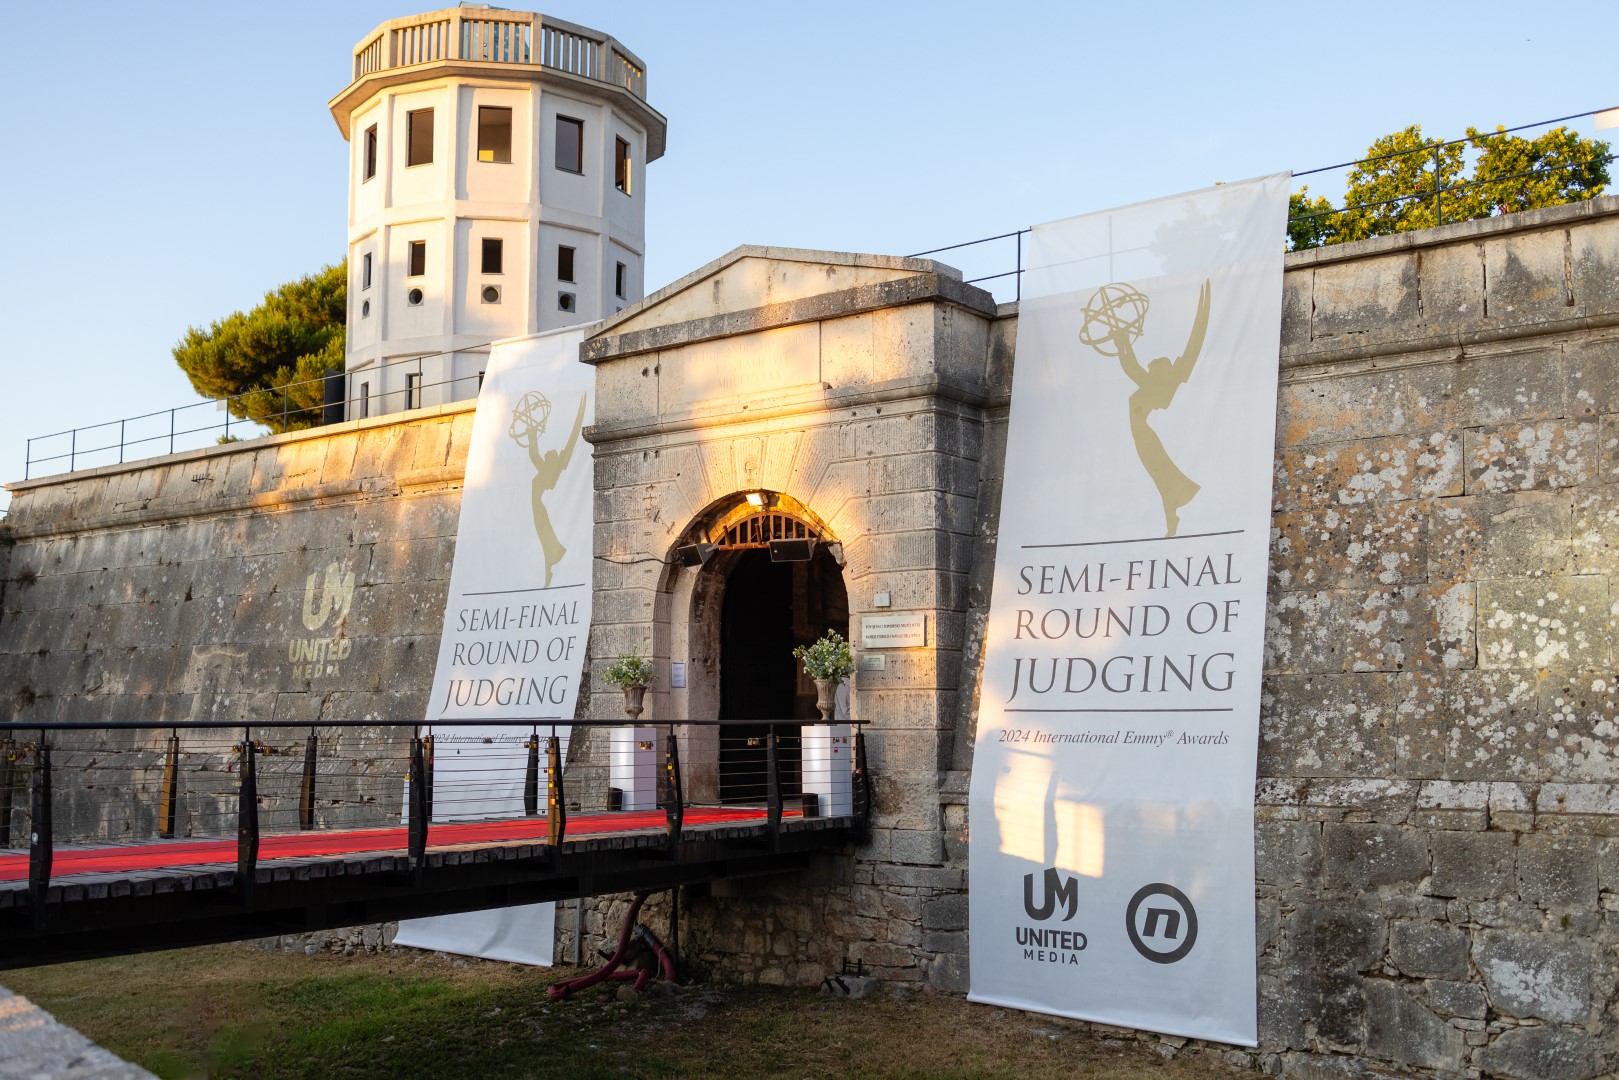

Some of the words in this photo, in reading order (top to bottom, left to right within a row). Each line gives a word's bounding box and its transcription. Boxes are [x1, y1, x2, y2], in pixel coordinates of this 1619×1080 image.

[1017, 553, 1242, 595] SEMI-FINAL
[456, 601, 580, 632] SEMI-FINAL
[1013, 604, 1170, 640] ROUND
[1186, 599, 1241, 635] OF
[288, 638, 352, 662] UNITED
[451, 639, 540, 666] ROUND
[546, 636, 577, 661] OF
[1006, 652, 1237, 704] JUDGING
[440, 675, 568, 715] JUDGING
[451, 733, 499, 743] Internatial
[998, 729, 1031, 743] 2024
[1033, 730, 1121, 744] International
[1176, 730, 1230, 745] Awards
[1023, 867, 1079, 922] UM
[1015, 926, 1088, 951] UNITED
[1023, 948, 1079, 965] MEDIA
